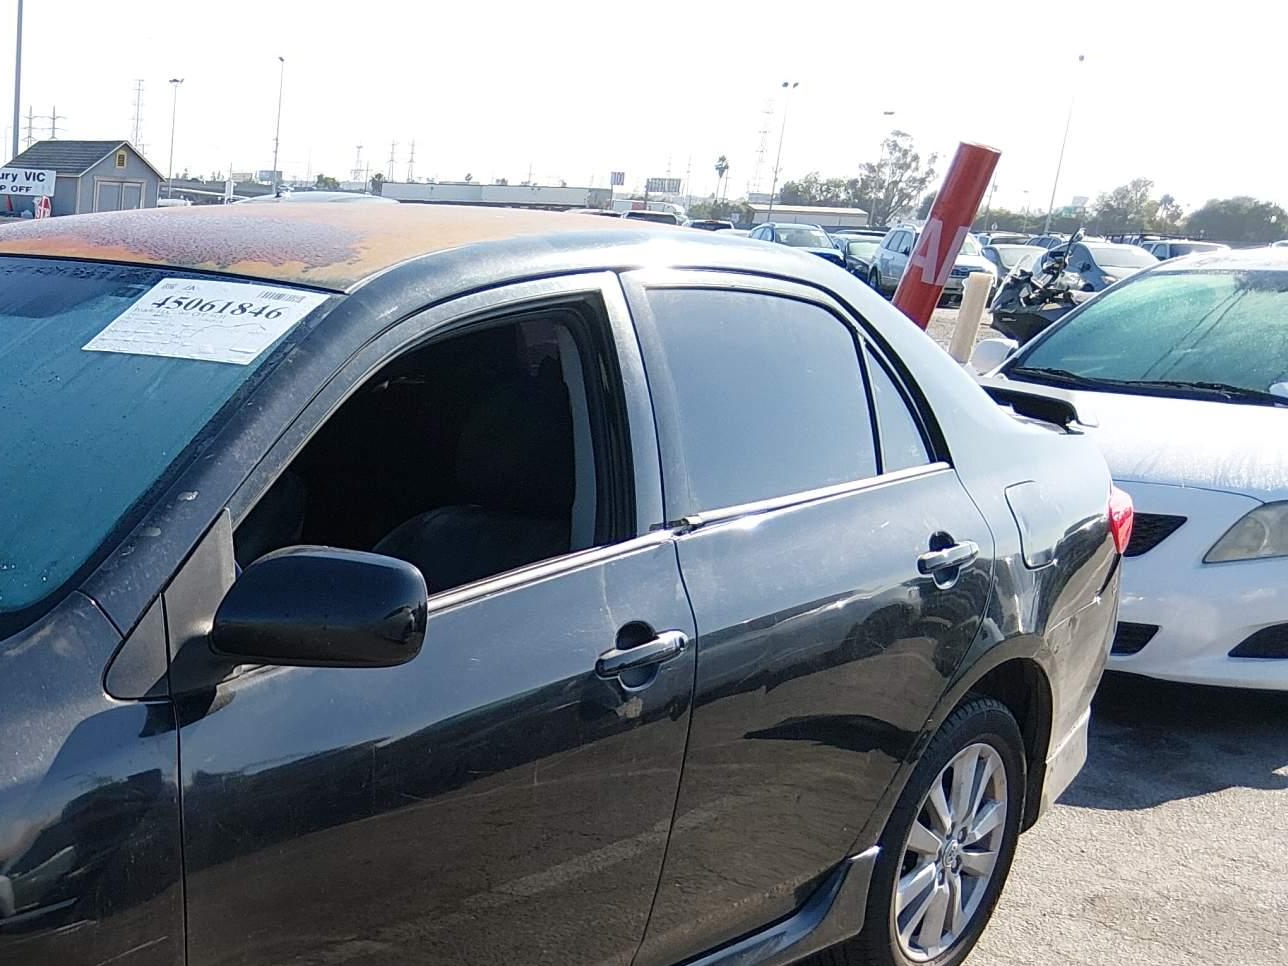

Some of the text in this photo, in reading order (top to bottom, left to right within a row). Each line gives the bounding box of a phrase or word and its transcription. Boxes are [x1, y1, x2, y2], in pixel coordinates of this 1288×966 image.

[24, 171, 46, 182] VIC
[10, 185, 32, 193] OFF
[152, 295, 289, 320] 45061846
